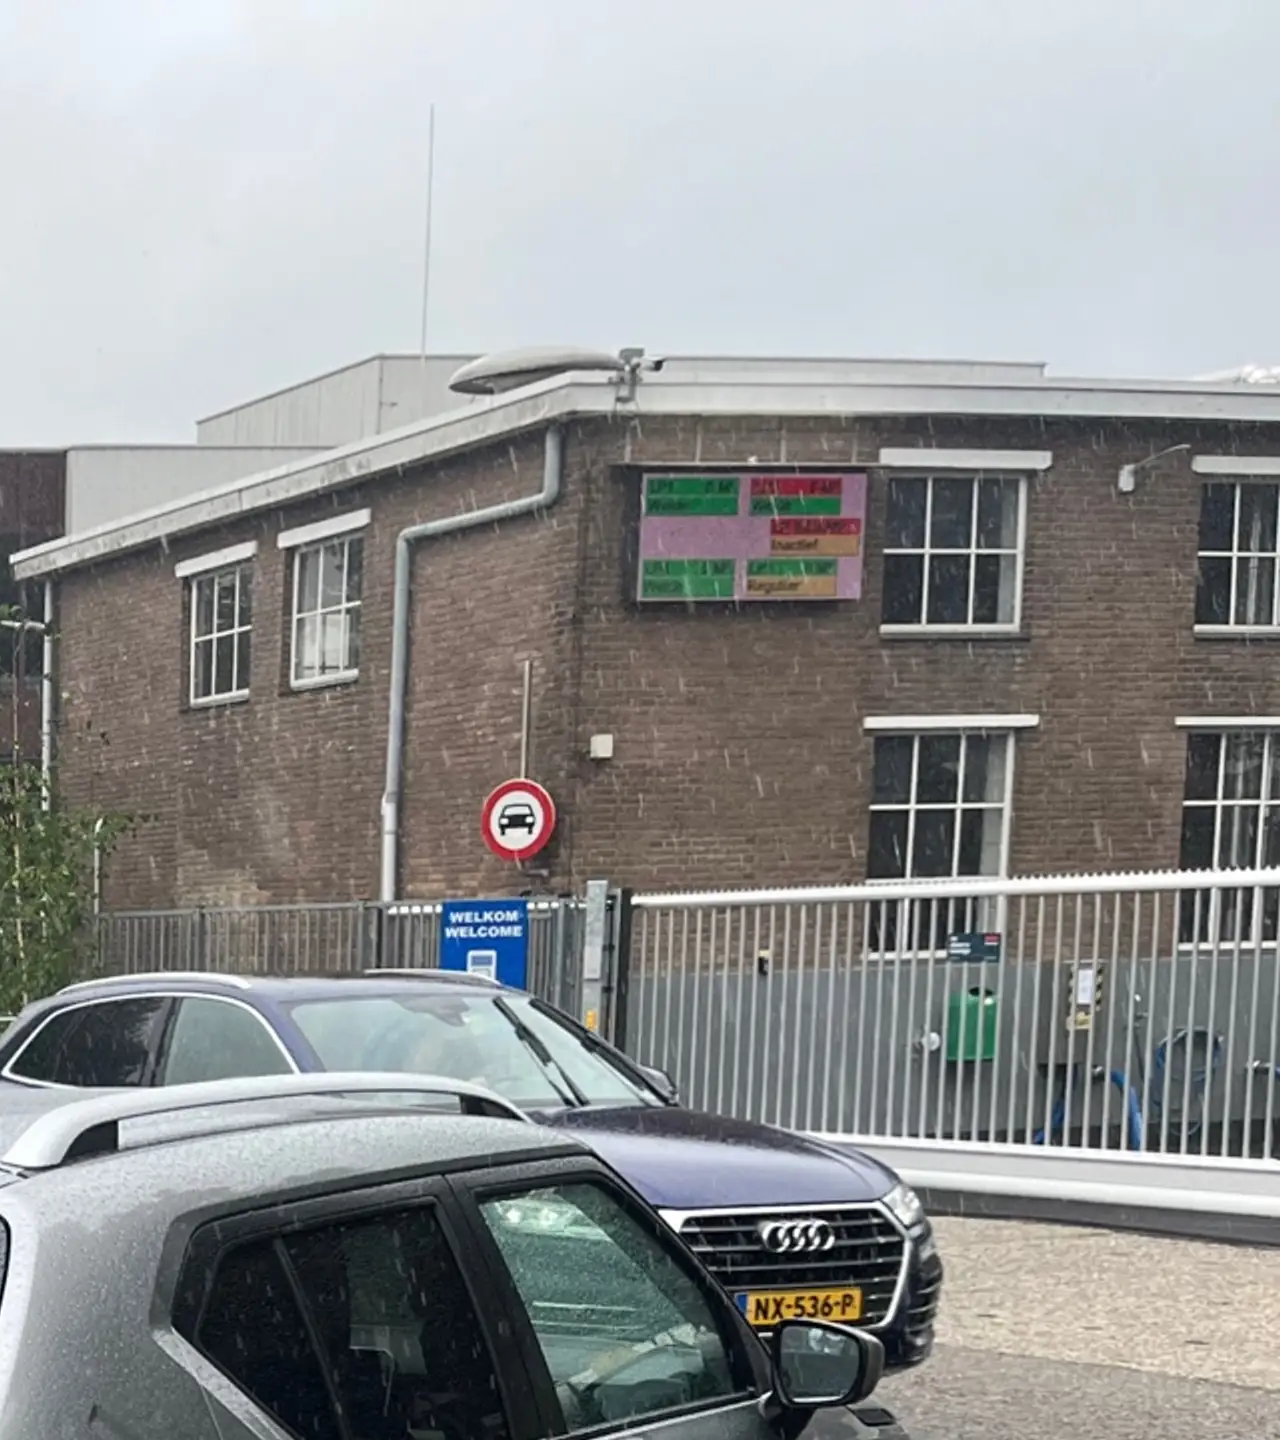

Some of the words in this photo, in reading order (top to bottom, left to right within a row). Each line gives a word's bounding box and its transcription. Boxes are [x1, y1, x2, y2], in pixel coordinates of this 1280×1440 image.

[448, 910, 519, 923] WELKOM
[444, 925, 523, 938] WELCOME
[753, 1293, 854, 1321] NX-536-P
